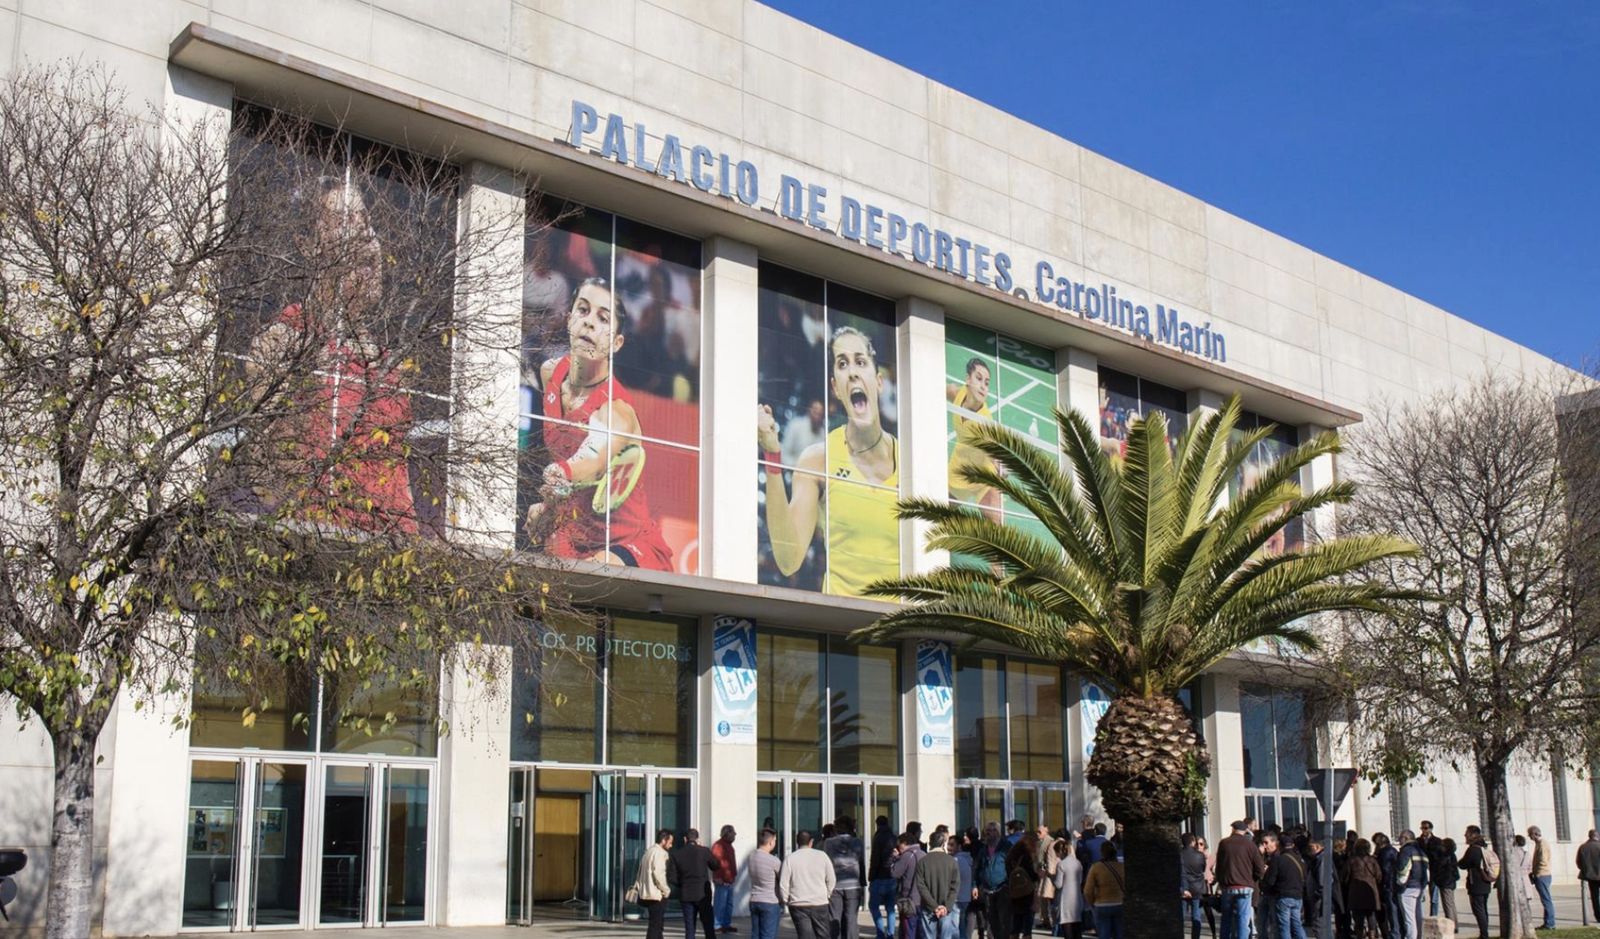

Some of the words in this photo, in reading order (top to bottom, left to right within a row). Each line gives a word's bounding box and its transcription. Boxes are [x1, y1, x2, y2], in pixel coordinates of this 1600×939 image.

[571, 99, 759, 206] PALACIO
[780, 174, 827, 229] DE
[841, 195, 1013, 292] DEPORTES
[1036, 260, 1150, 338] Carolina
[1156, 304, 1227, 362] Marín
